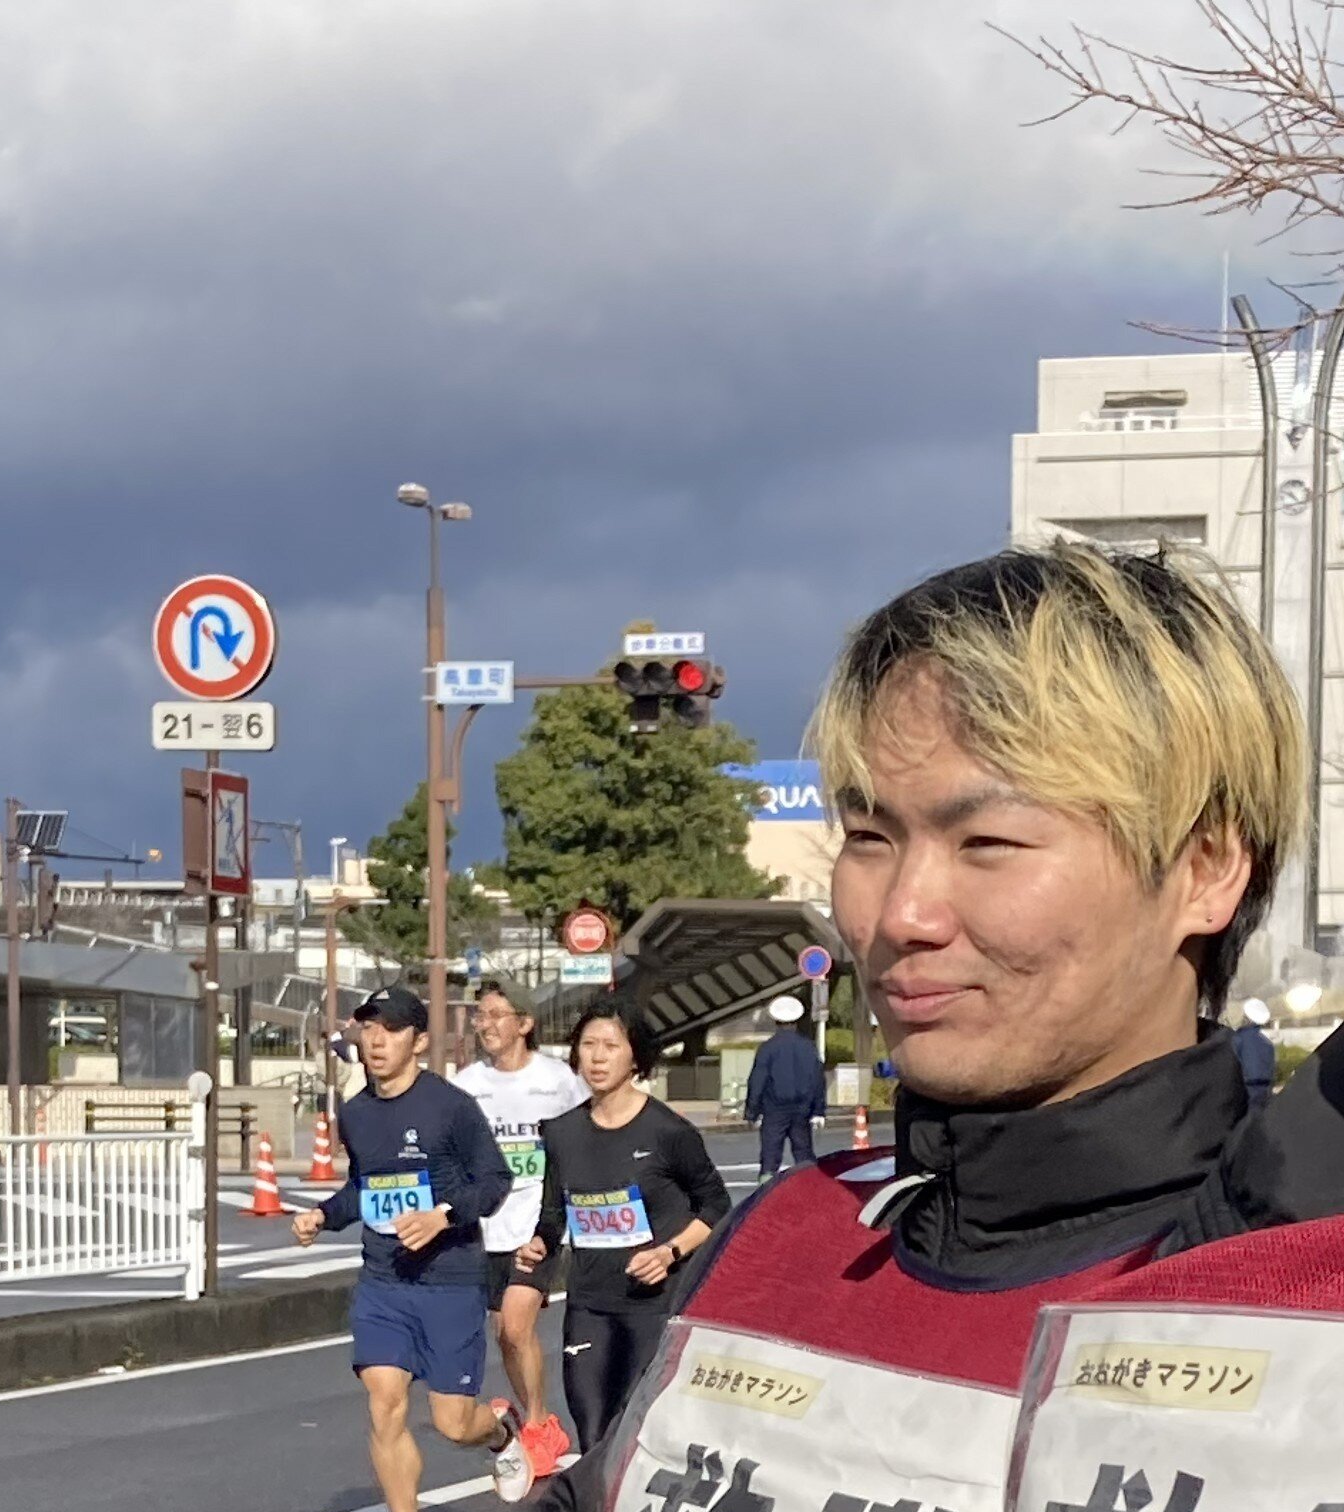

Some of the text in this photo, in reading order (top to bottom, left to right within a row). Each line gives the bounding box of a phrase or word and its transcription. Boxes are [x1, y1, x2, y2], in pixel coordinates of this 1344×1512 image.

[370, 1191, 420, 1220] 1419
[574, 1207, 636, 1234] 5049
[689, 1362, 809, 1406] おおがきマラソン
[1076, 1356, 1255, 1395] おおがきマラソン
